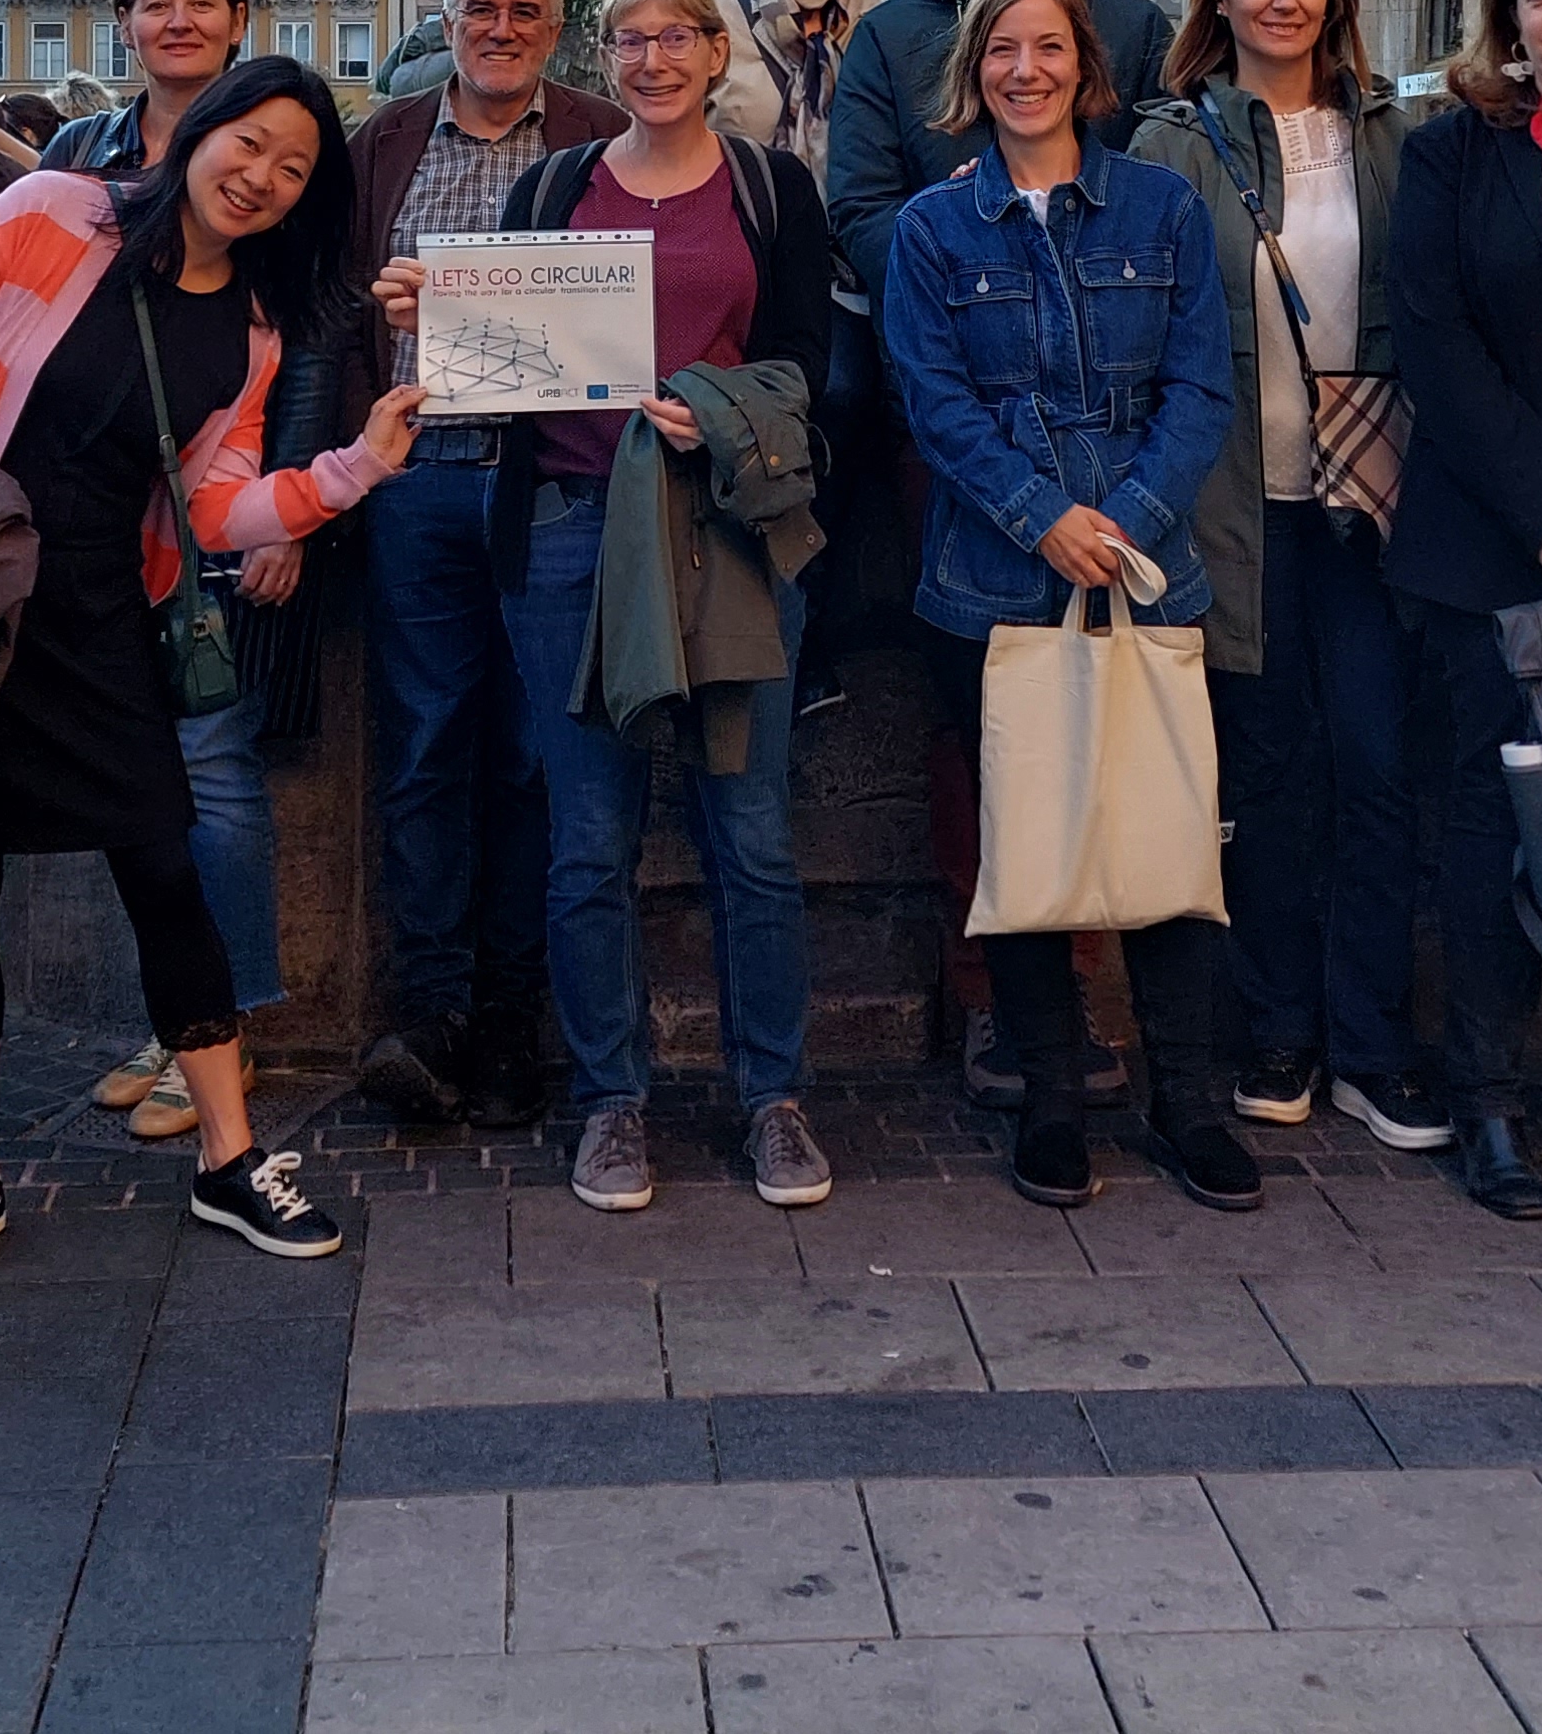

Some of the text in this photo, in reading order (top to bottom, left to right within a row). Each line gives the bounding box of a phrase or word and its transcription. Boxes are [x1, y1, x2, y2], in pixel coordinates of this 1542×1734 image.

[432, 265, 636, 287] LET'S GO CIRCULAR!
[464, 288, 478, 297] the
[515, 288, 522, 296] a
[523, 286, 557, 295] circular
[560, 285, 599, 294] transition
[601, 285, 610, 294] of
[612, 285, 635, 293] cities
